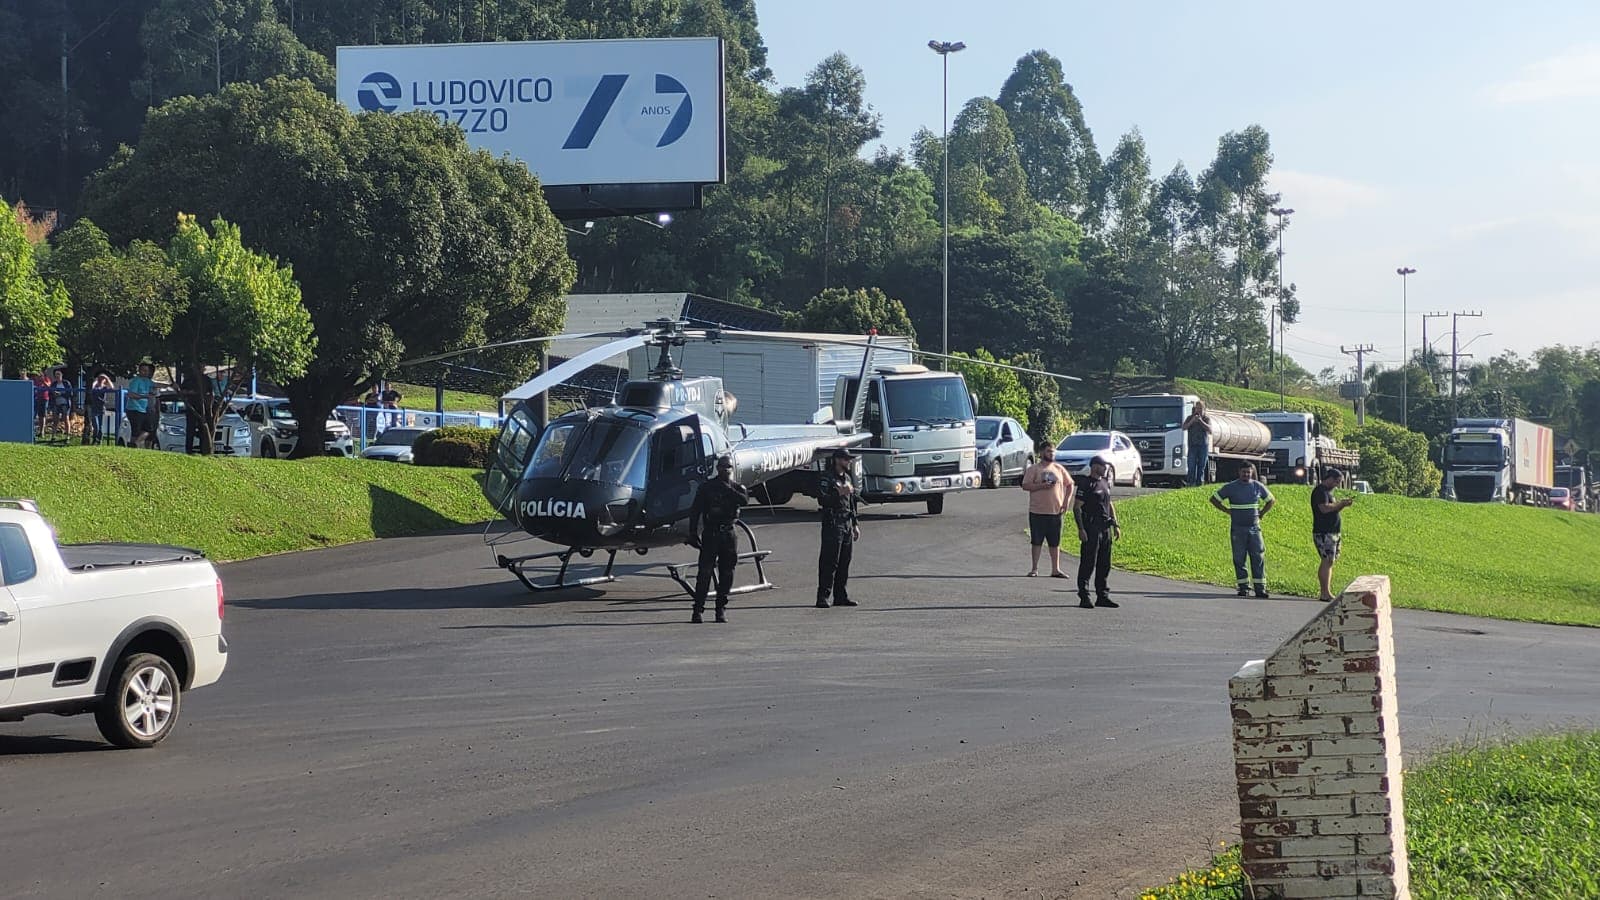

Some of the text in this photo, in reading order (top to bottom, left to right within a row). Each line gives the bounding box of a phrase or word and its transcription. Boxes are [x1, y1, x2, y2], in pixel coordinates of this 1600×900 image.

[413, 77, 552, 106] LUDOVICO
[433, 107, 508, 133] ZZO
[641, 105, 671, 116] ANOS
[520, 496, 586, 519] POLÍCIA
